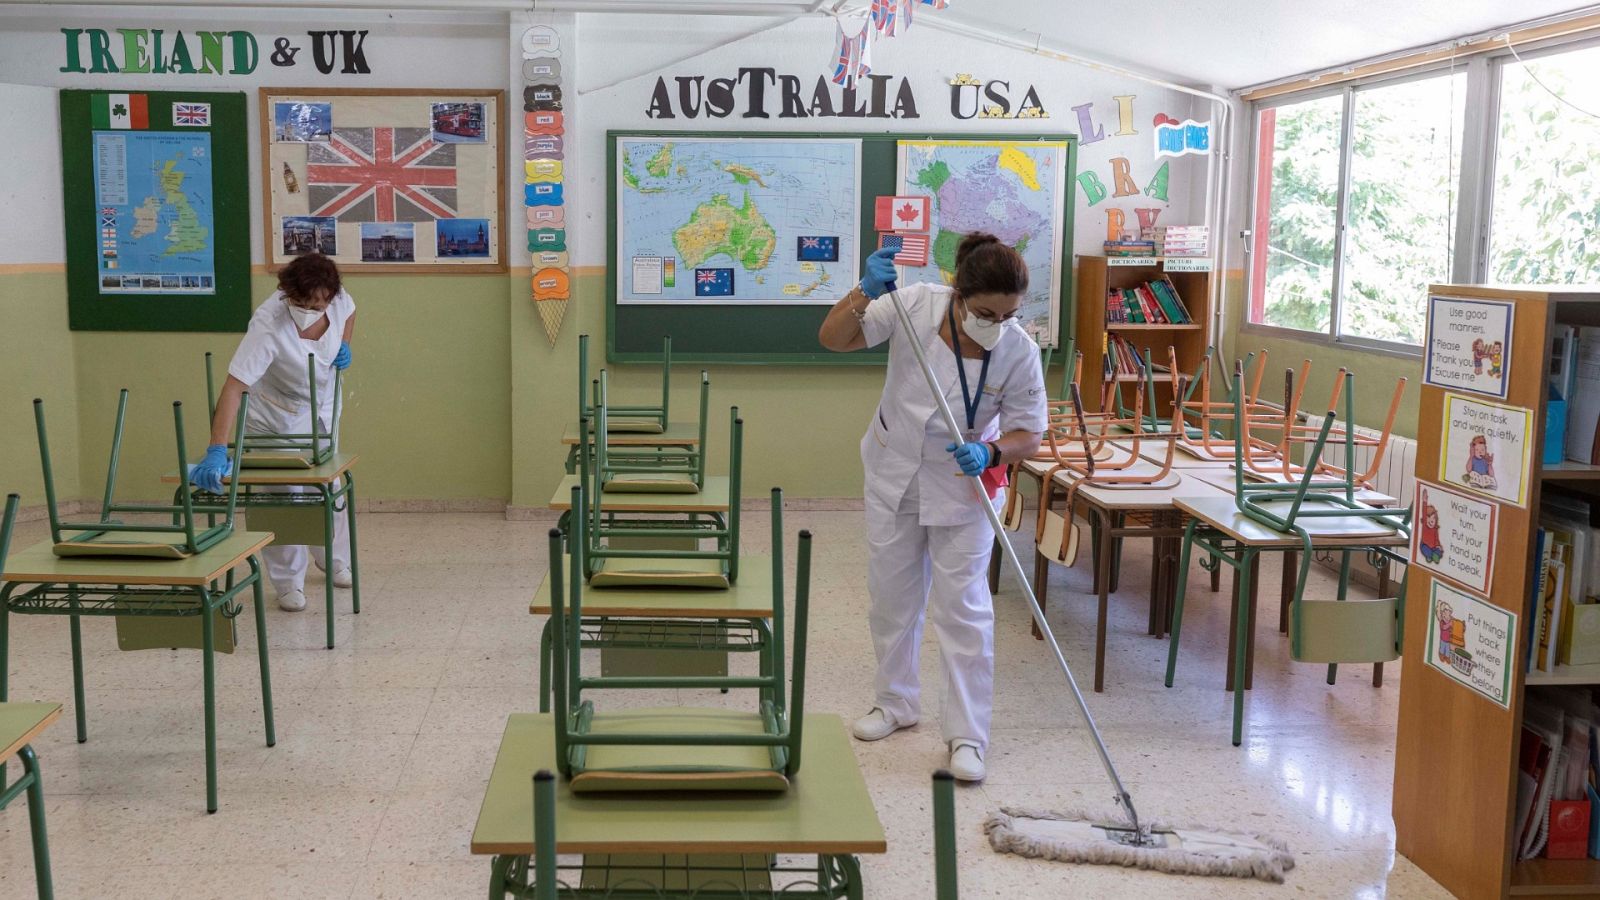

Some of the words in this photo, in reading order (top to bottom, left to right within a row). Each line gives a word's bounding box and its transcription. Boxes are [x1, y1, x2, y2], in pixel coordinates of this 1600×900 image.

[59, 28, 259, 75] IRELAND
[270, 37, 300, 67] &
[307, 30, 371, 75] UK
[645, 67, 920, 120] AUSTRALIA
[950, 79, 1050, 120] USA
[1449, 307, 1463, 317] Use
[1465, 309, 1487, 320] good
[1449, 322, 1486, 334] manners.
[1436, 338, 1460, 351] Please
[1436, 352, 1456, 364] Thank
[1459, 359, 1474, 368] you
[1435, 366, 1460, 379] Excuse
[1461, 373, 1475, 382] me
[1463, 405, 1477, 418] Stay
[1479, 411, 1489, 420] on
[1490, 413, 1508, 425] task
[1453, 419, 1467, 430] and
[1469, 423, 1485, 434] work
[1487, 427, 1519, 443] quietly.
[1451, 501, 1468, 514] Wait
[1469, 508, 1488, 521] your
[1451, 529, 1464, 541] Put
[1465, 536, 1483, 548] your
[1450, 543, 1470, 558] hand
[1471, 553, 1482, 564] up
[1448, 556, 1456, 566] to
[1457, 561, 1482, 578] speak.
[1468, 613, 1482, 626] Put
[1482, 619, 1506, 640] things
[1478, 634, 1500, 651] back
[1475, 647, 1501, 666] where
[1478, 662, 1496, 680] they
[1472, 673, 1504, 699] belong.
